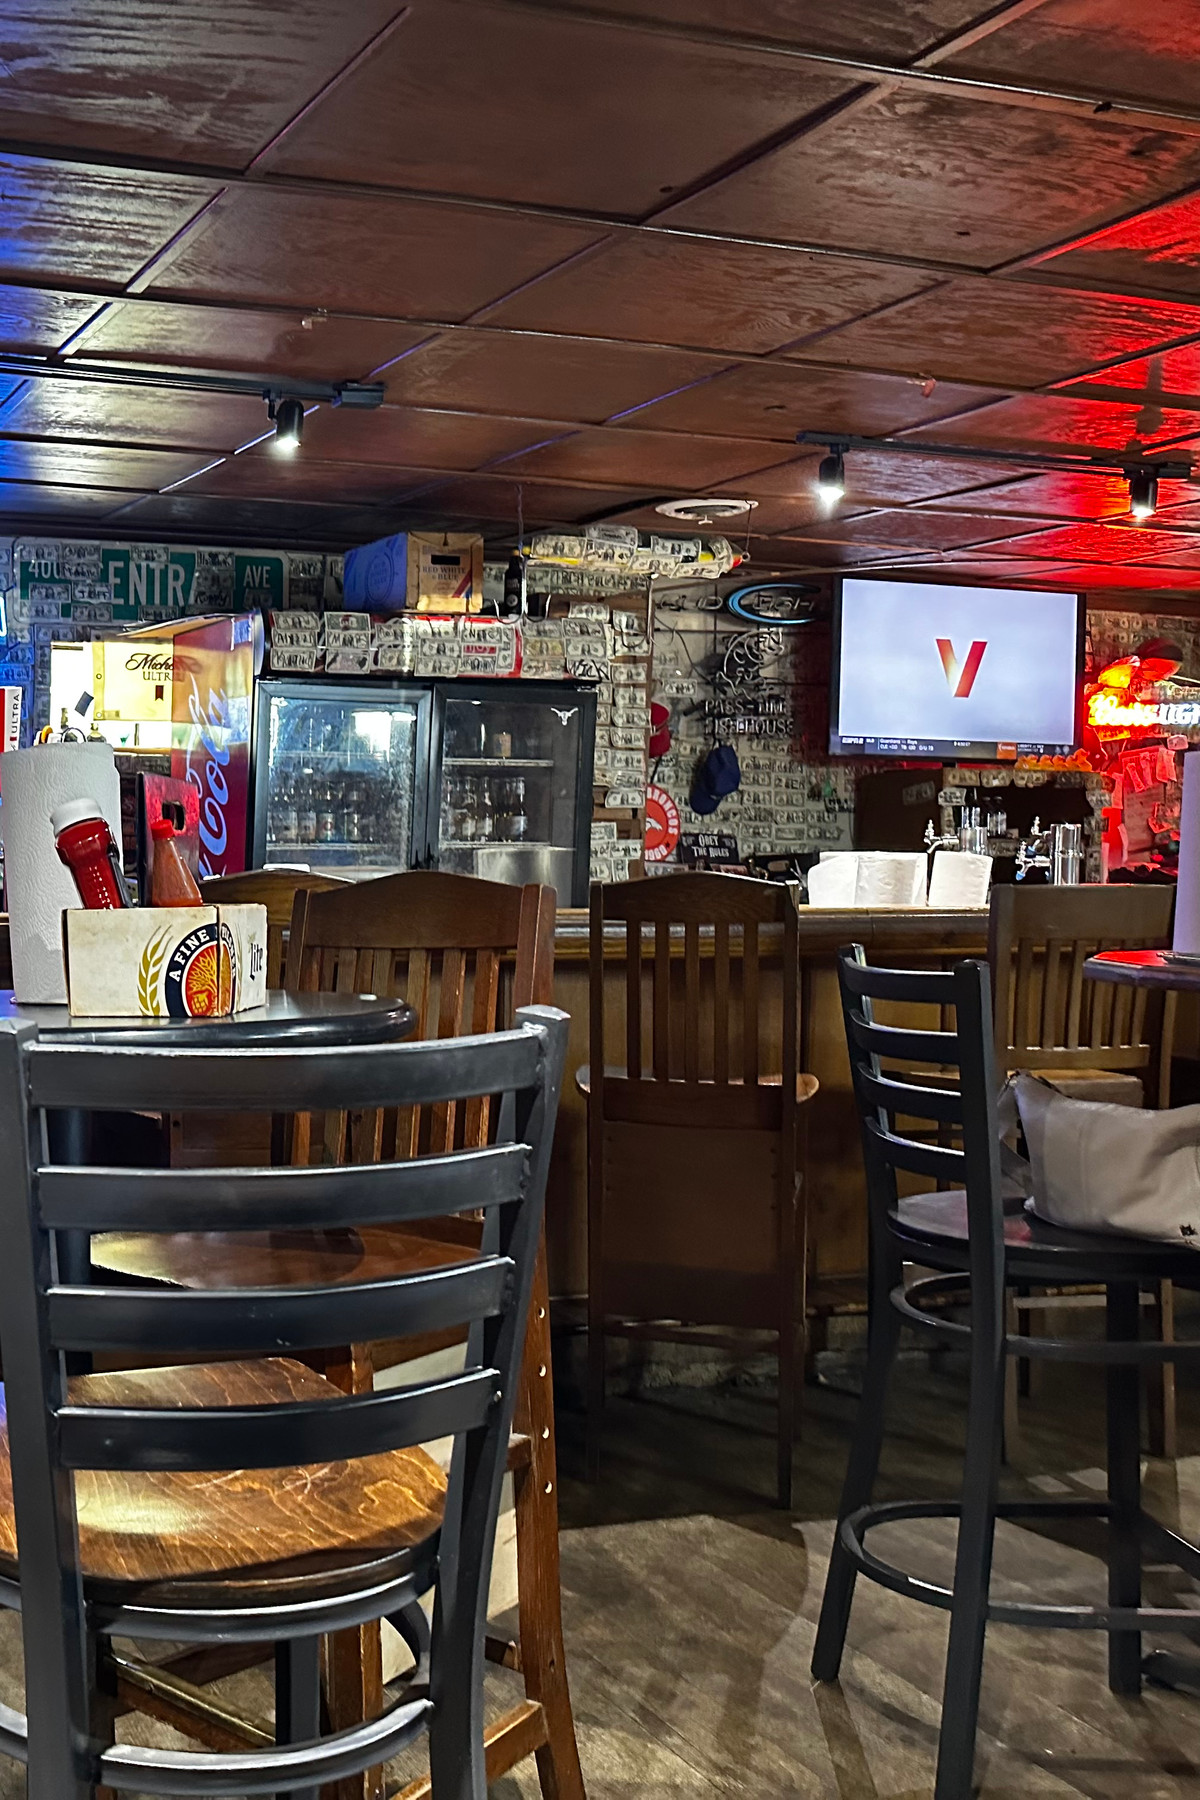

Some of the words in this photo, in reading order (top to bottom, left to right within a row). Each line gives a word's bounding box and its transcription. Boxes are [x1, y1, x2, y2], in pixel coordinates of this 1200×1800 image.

[243, 563, 272, 588] AVE
[142, 671, 173, 682] ULTR
[11, 693, 19, 734] ULTRA
[698, 834, 719, 847] OBEY
[692, 846, 707, 857] THE
[709, 847, 730, 858] RULES
[173, 929, 210, 966] FINE
[249, 942, 264, 981] lite
[169, 969, 182, 982] A
